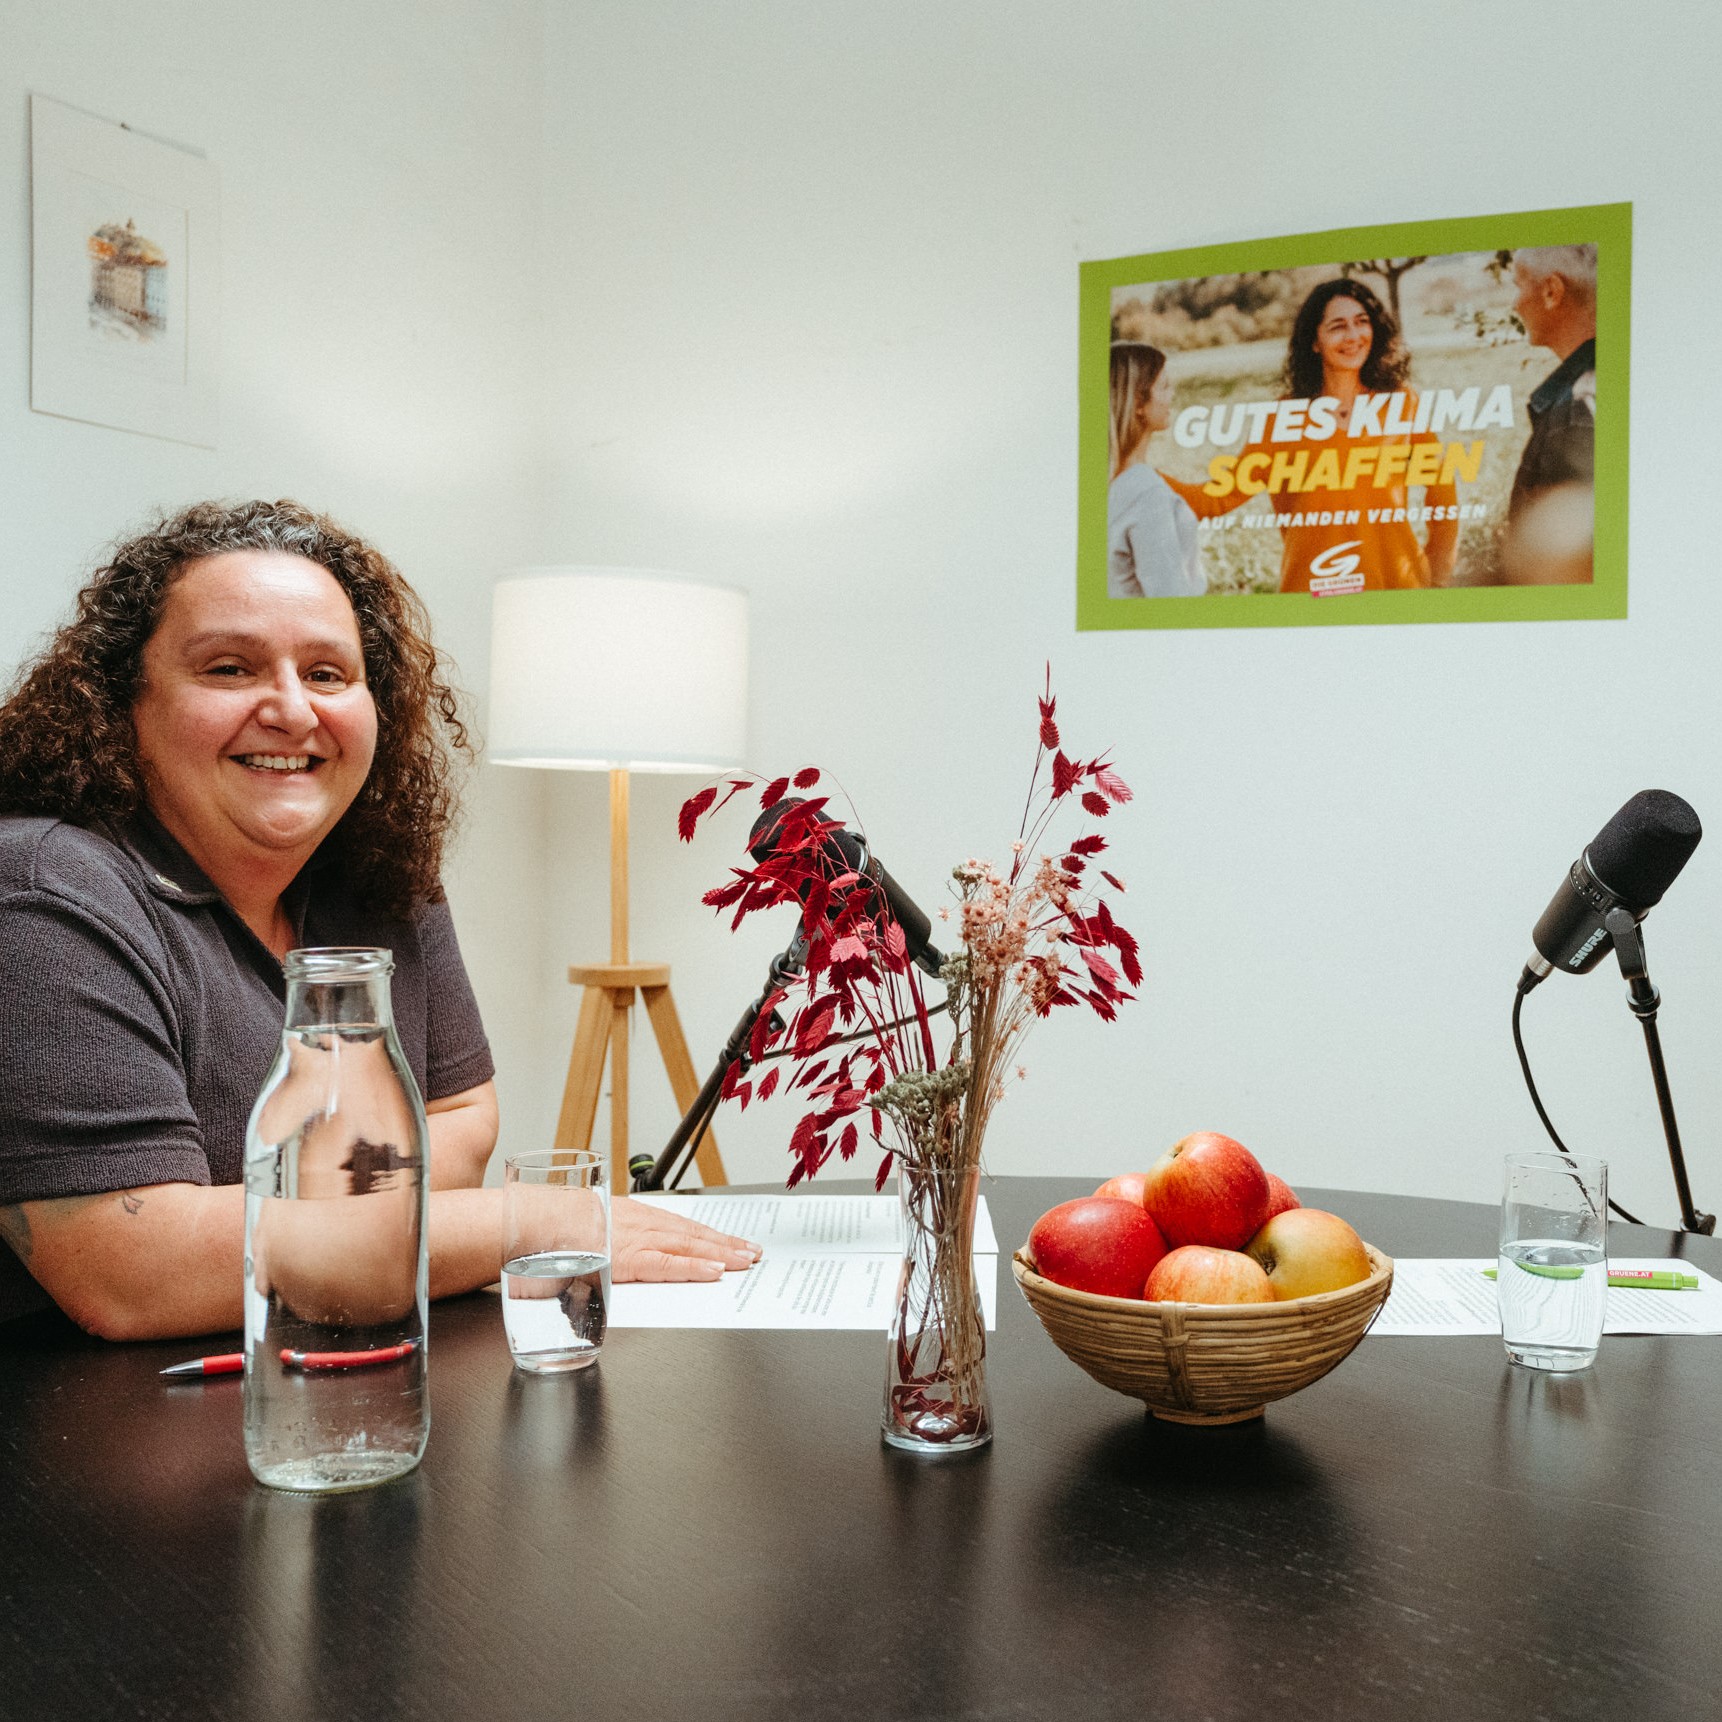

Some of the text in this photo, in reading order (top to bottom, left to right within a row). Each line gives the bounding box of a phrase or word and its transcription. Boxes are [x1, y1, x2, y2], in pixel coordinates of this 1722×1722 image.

[1173, 384, 1515, 448] GUTES KLIMA
[1202, 440, 1486, 498] SCHAFFEN
[1197, 504, 1488, 531] AUF NIEMANDEN VERGESSEN
[1568, 927, 1608, 968] SHURE
[1609, 1270, 1650, 1278] GRUENE.AT
